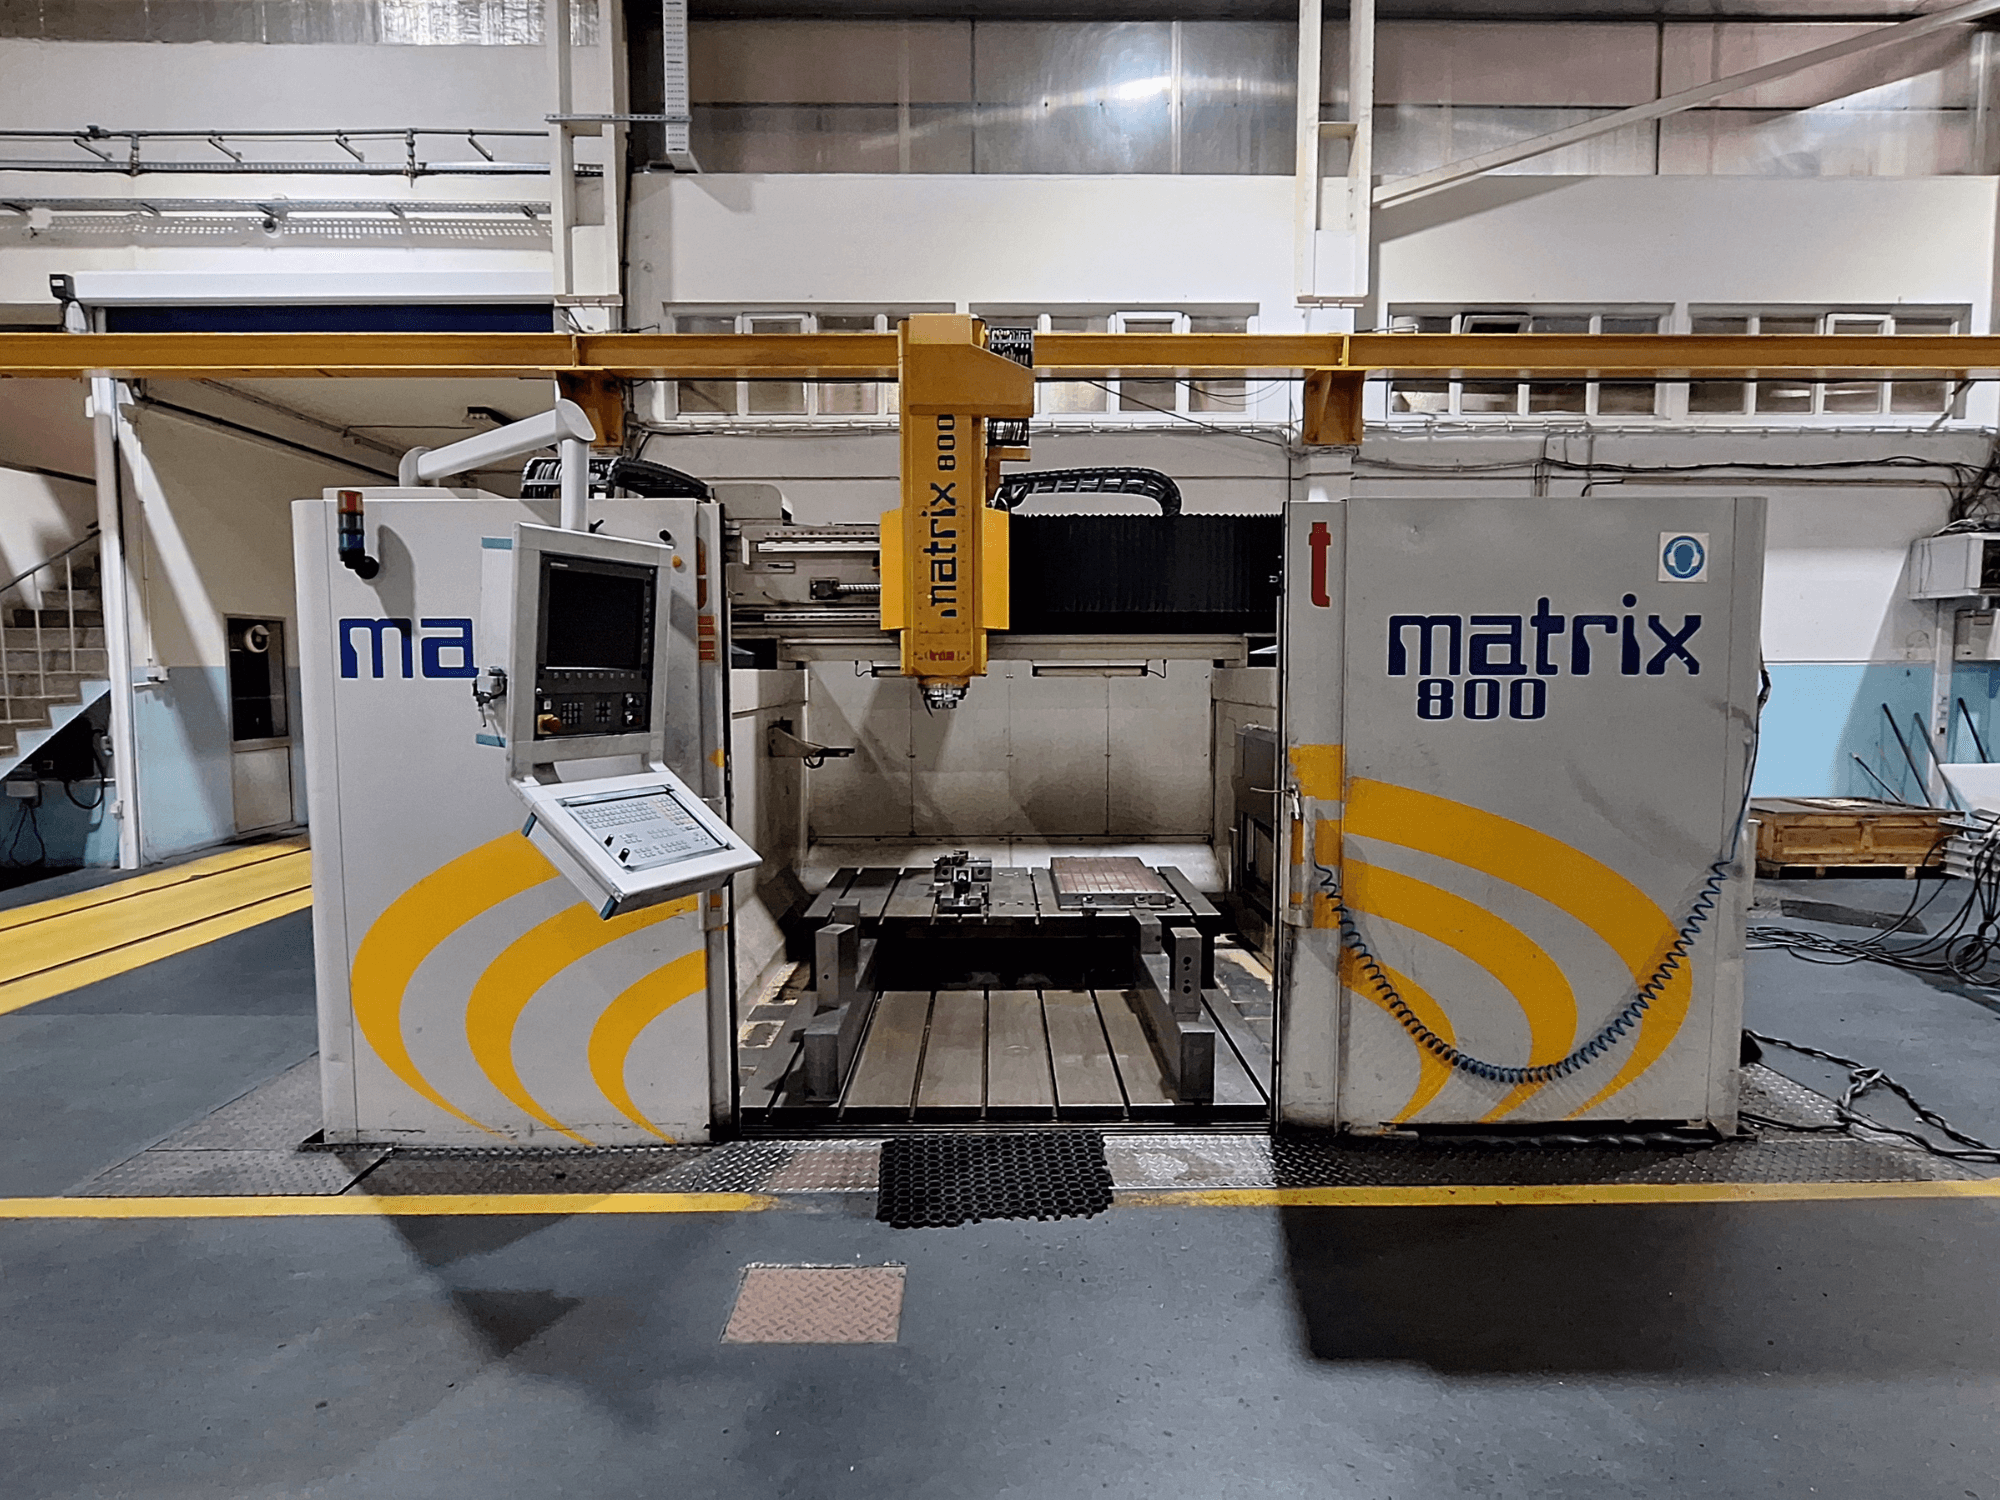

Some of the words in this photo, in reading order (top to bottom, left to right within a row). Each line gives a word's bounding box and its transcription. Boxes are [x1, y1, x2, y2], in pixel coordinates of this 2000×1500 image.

[937, 414, 956, 471] 800
[922, 482, 957, 618] matrix
[1387, 593, 1702, 676] matrix
[1416, 678, 1547, 720] 800
